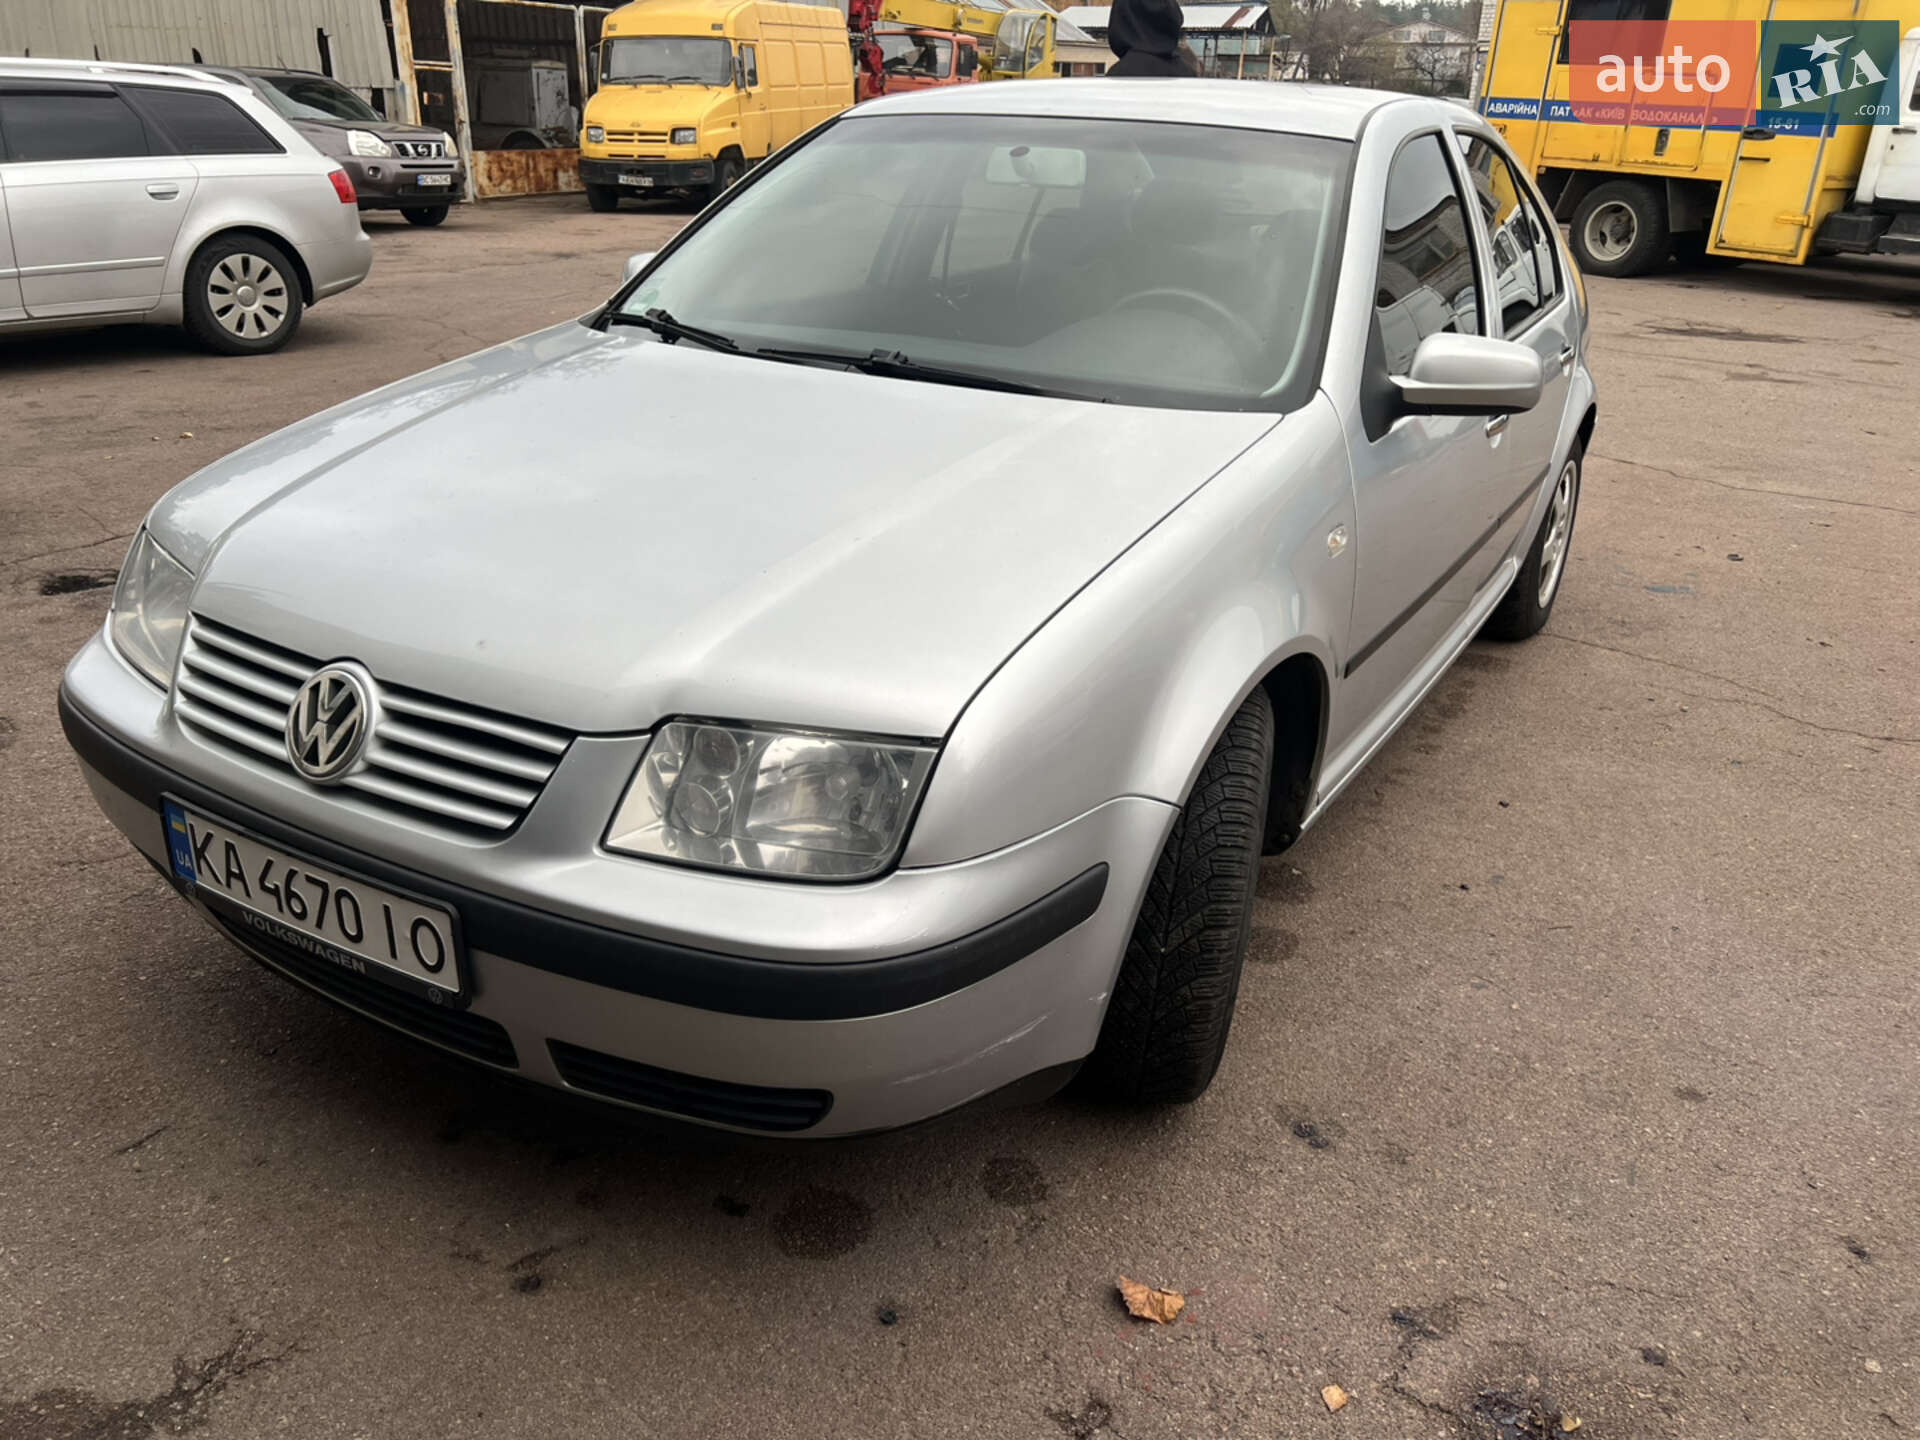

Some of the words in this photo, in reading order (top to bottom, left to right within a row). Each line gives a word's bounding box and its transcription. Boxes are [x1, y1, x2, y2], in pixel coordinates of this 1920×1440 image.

[1488, 102, 1538, 115] АВАРІЙНА
[1550, 105, 1571, 117] ПАТ
[175, 848, 193, 870] UA
[188, 823, 252, 898] KA
[259, 857, 364, 944] 4670
[383, 903, 445, 974] IO
[242, 910, 367, 975] VOLKSWAGEN
